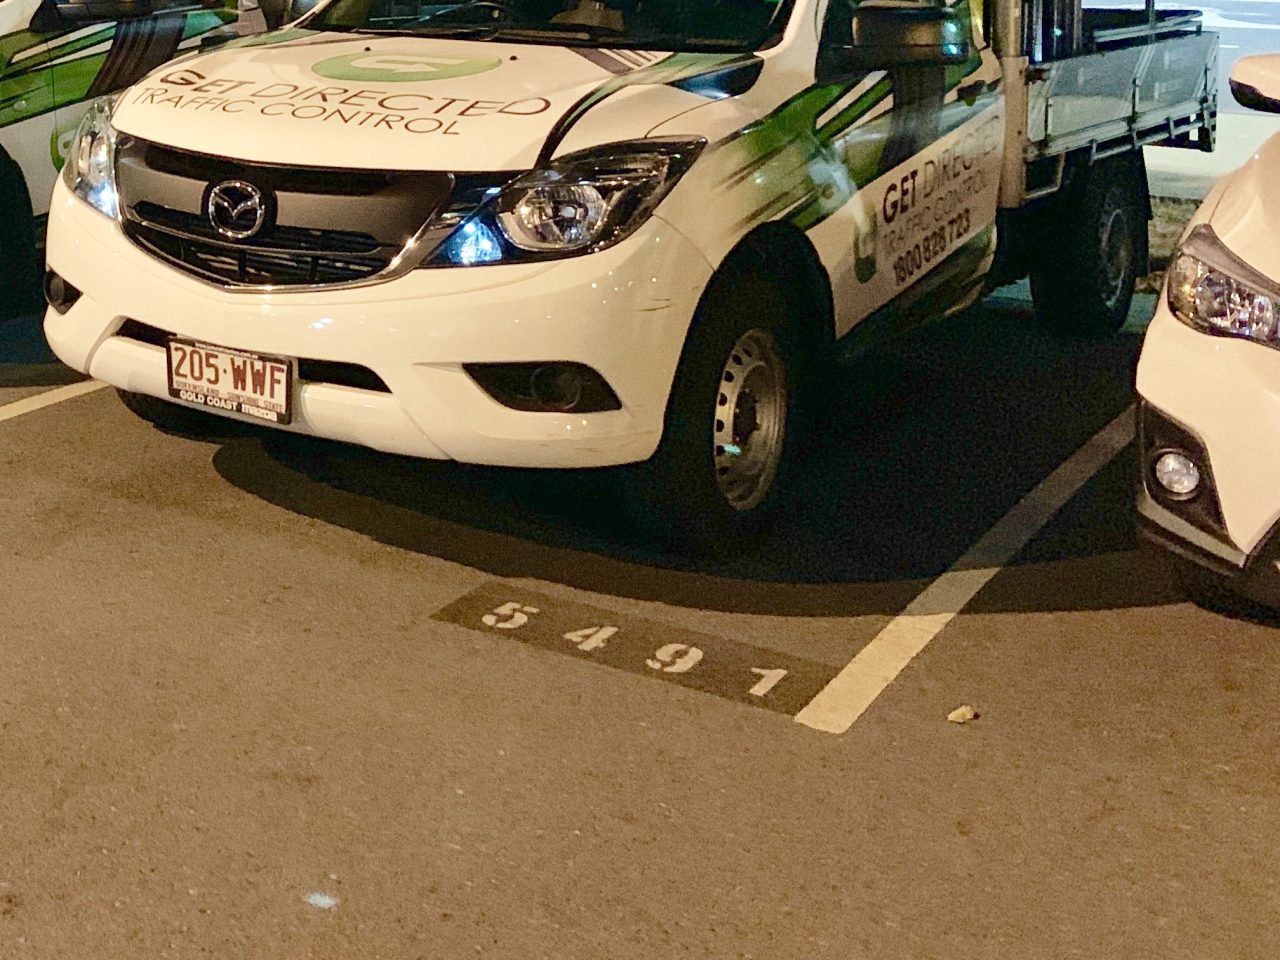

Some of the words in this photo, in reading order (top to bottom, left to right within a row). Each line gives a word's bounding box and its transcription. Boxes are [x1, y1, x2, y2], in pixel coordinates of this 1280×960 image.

[132, 87, 255, 115] TRAFFIC
[260, 101, 461, 135] CONTROL
[159, 69, 256, 94] GET
[250, 82, 551, 117] DIRECTED
[883, 169, 918, 224] GET
[894, 244, 923, 287] 1800
[923, 226, 947, 264] 828
[947, 208, 970, 244] 723
[180, 390, 205, 403] GOLD
[206, 397, 238, 411] COAST
[481, 602, 788, 697] 5491
